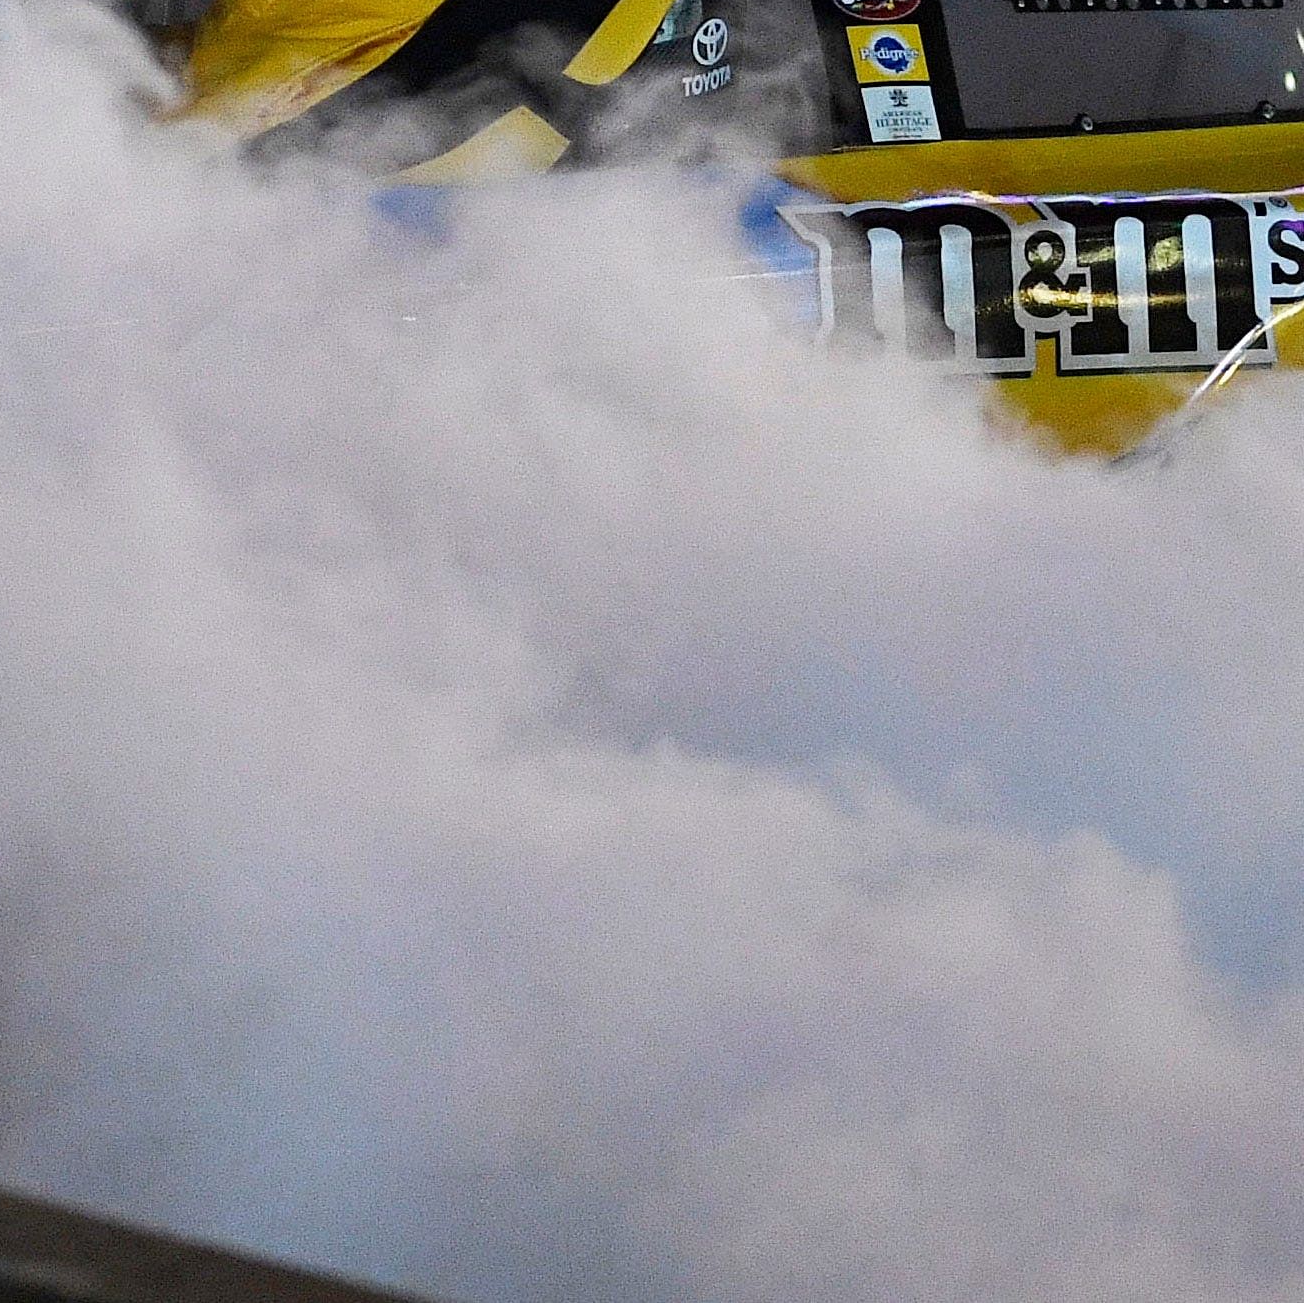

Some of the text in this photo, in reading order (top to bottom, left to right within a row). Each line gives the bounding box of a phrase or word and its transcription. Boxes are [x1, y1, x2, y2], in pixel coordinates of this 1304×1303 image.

[860, 46, 920, 62] Pedigree
[682, 64, 732, 97] TOYOTA
[875, 117, 933, 128] HERITAGE
